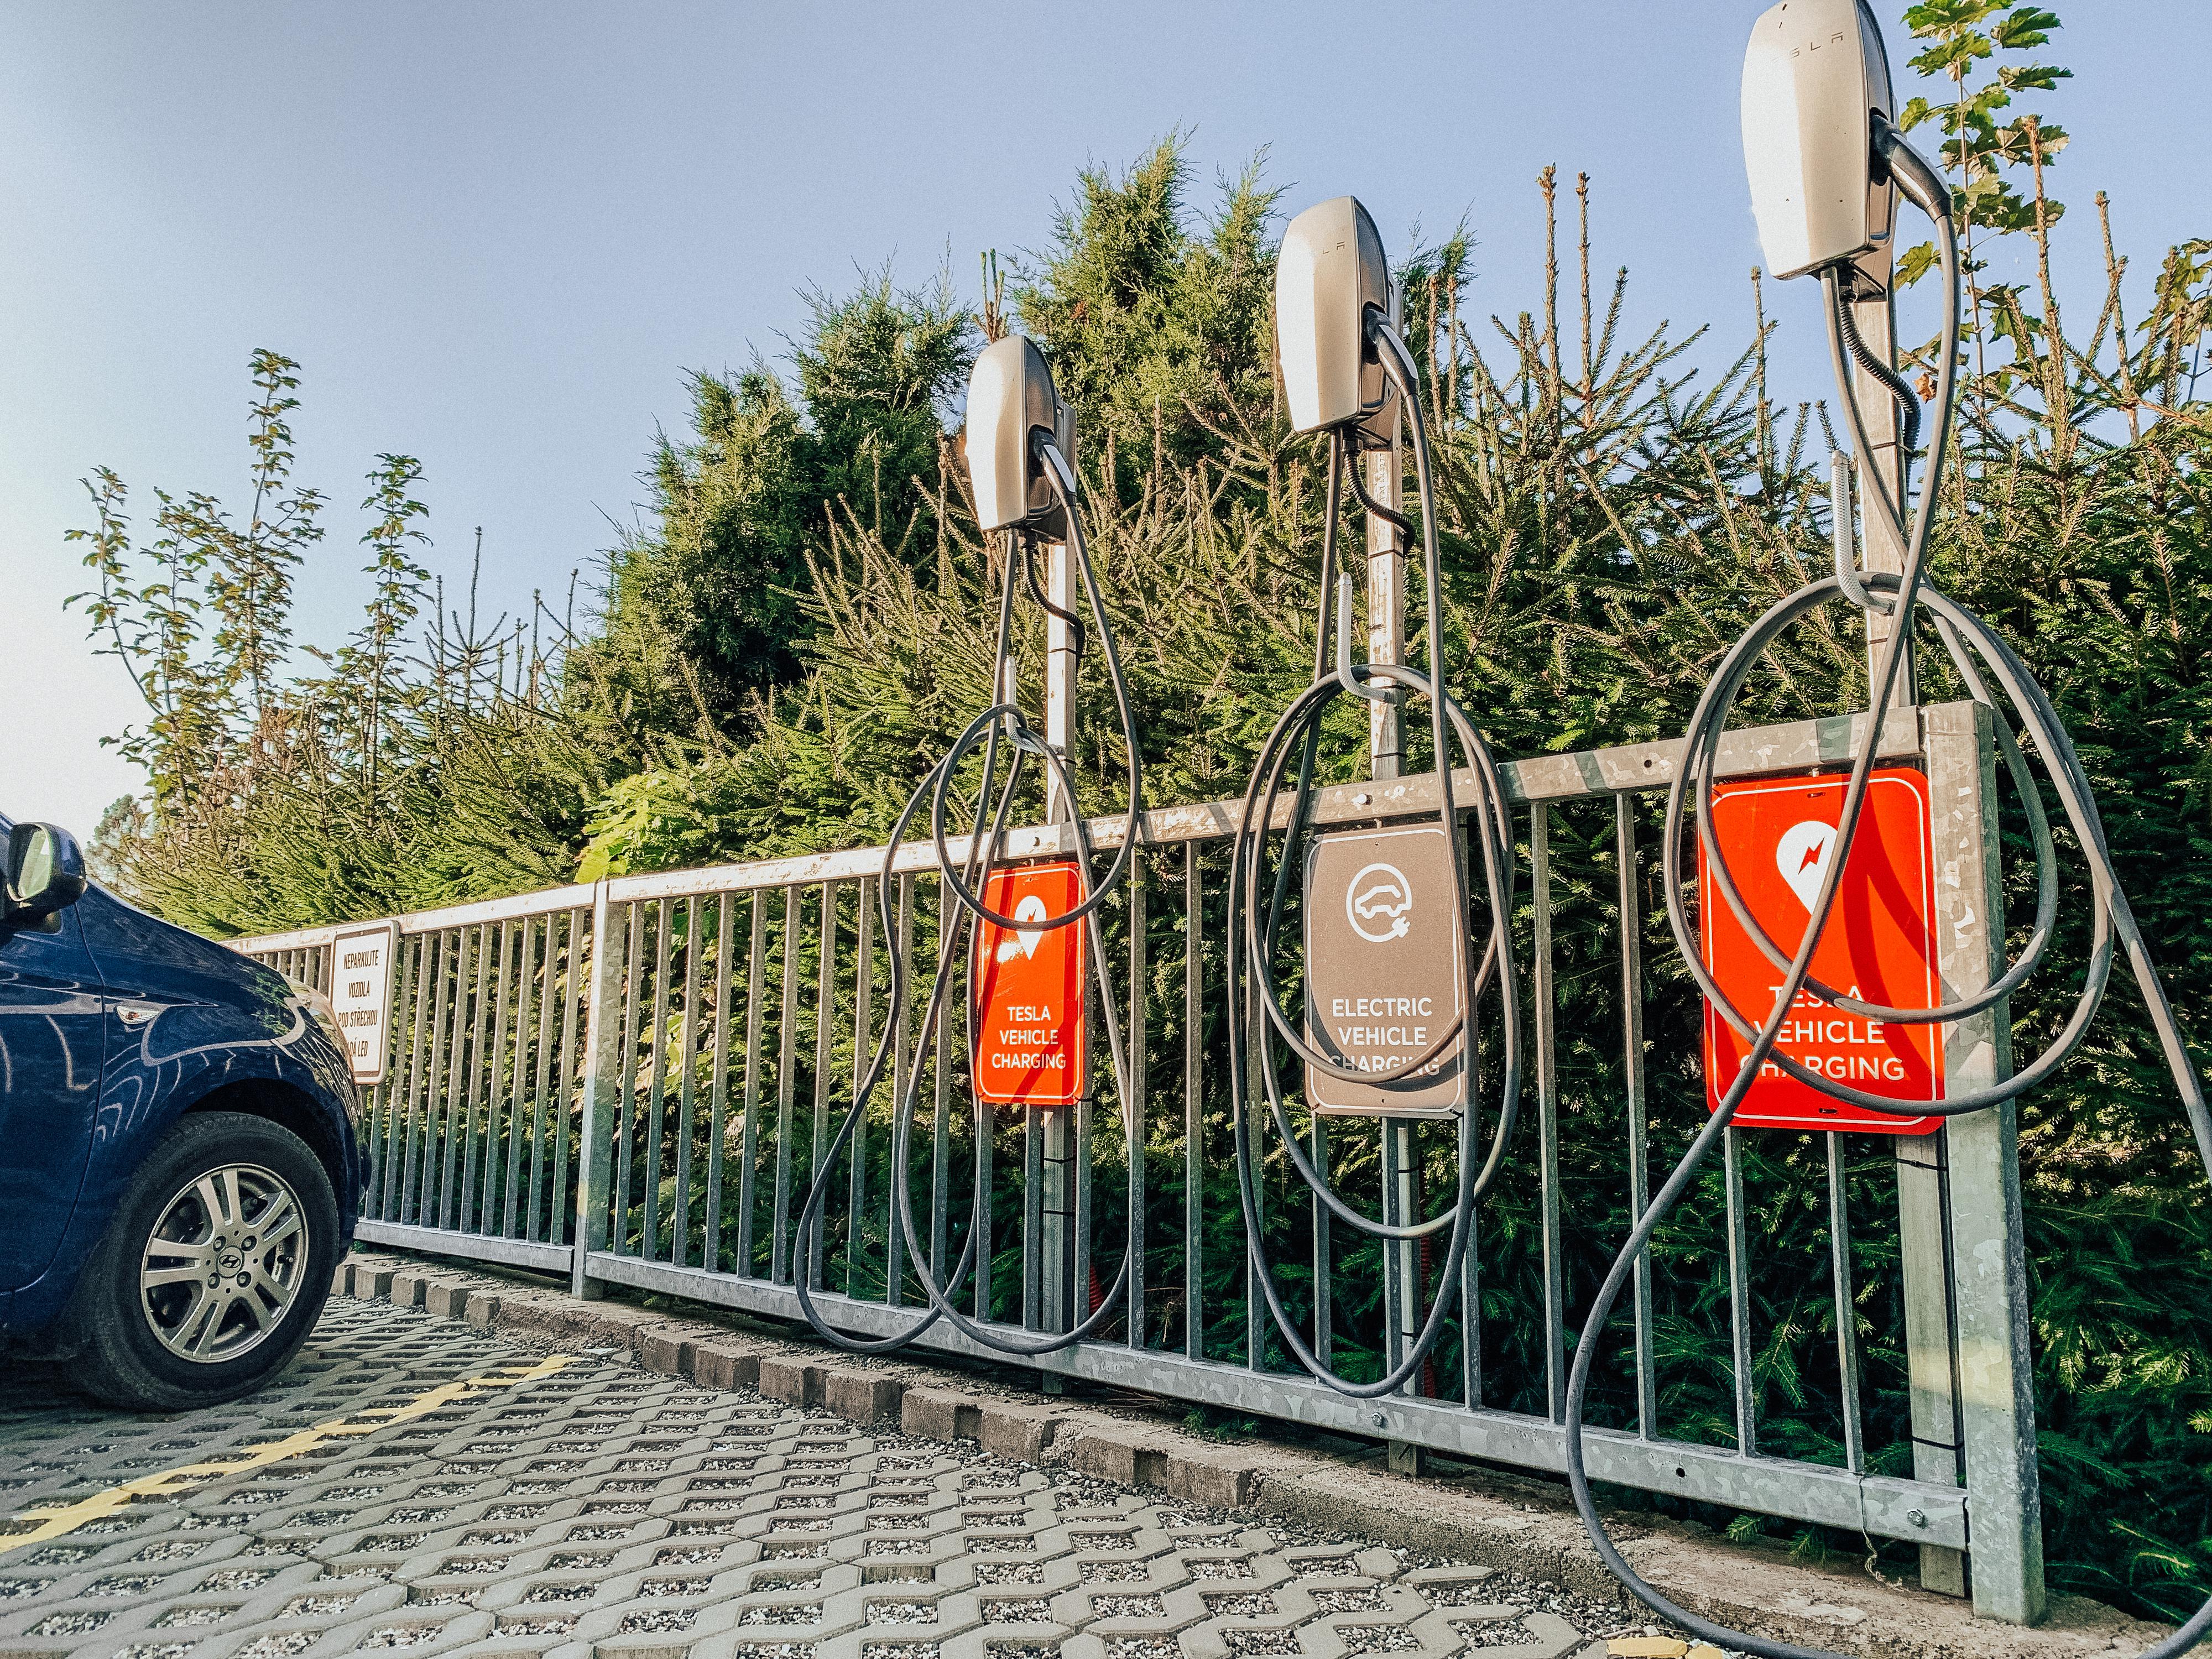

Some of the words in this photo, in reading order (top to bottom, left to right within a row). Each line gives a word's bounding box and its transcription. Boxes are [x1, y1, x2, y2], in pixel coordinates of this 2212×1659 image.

[343, 950, 379, 970] NEPARKUJTE
[348, 980, 370, 998] VOZIDLA
[1769, 985, 1864, 1008] TSA
[338, 1012, 349, 1027] POD
[350, 1006, 378, 1027] STŘECHOU
[1007, 1005, 1051, 1021] TESLA
[1332, 997, 1432, 1017] ELECTRIC
[999, 1029, 1058, 1045] VEHICLE
[1338, 1026, 1427, 1046] VEHICLE
[347, 1037, 356, 1057] DÁ
[358, 1040, 368, 1057] LED
[992, 1053, 1066, 1069] CHARGING
[1329, 1055, 1439, 1076] HARGG
[1740, 1055, 1905, 1081] HRGING
